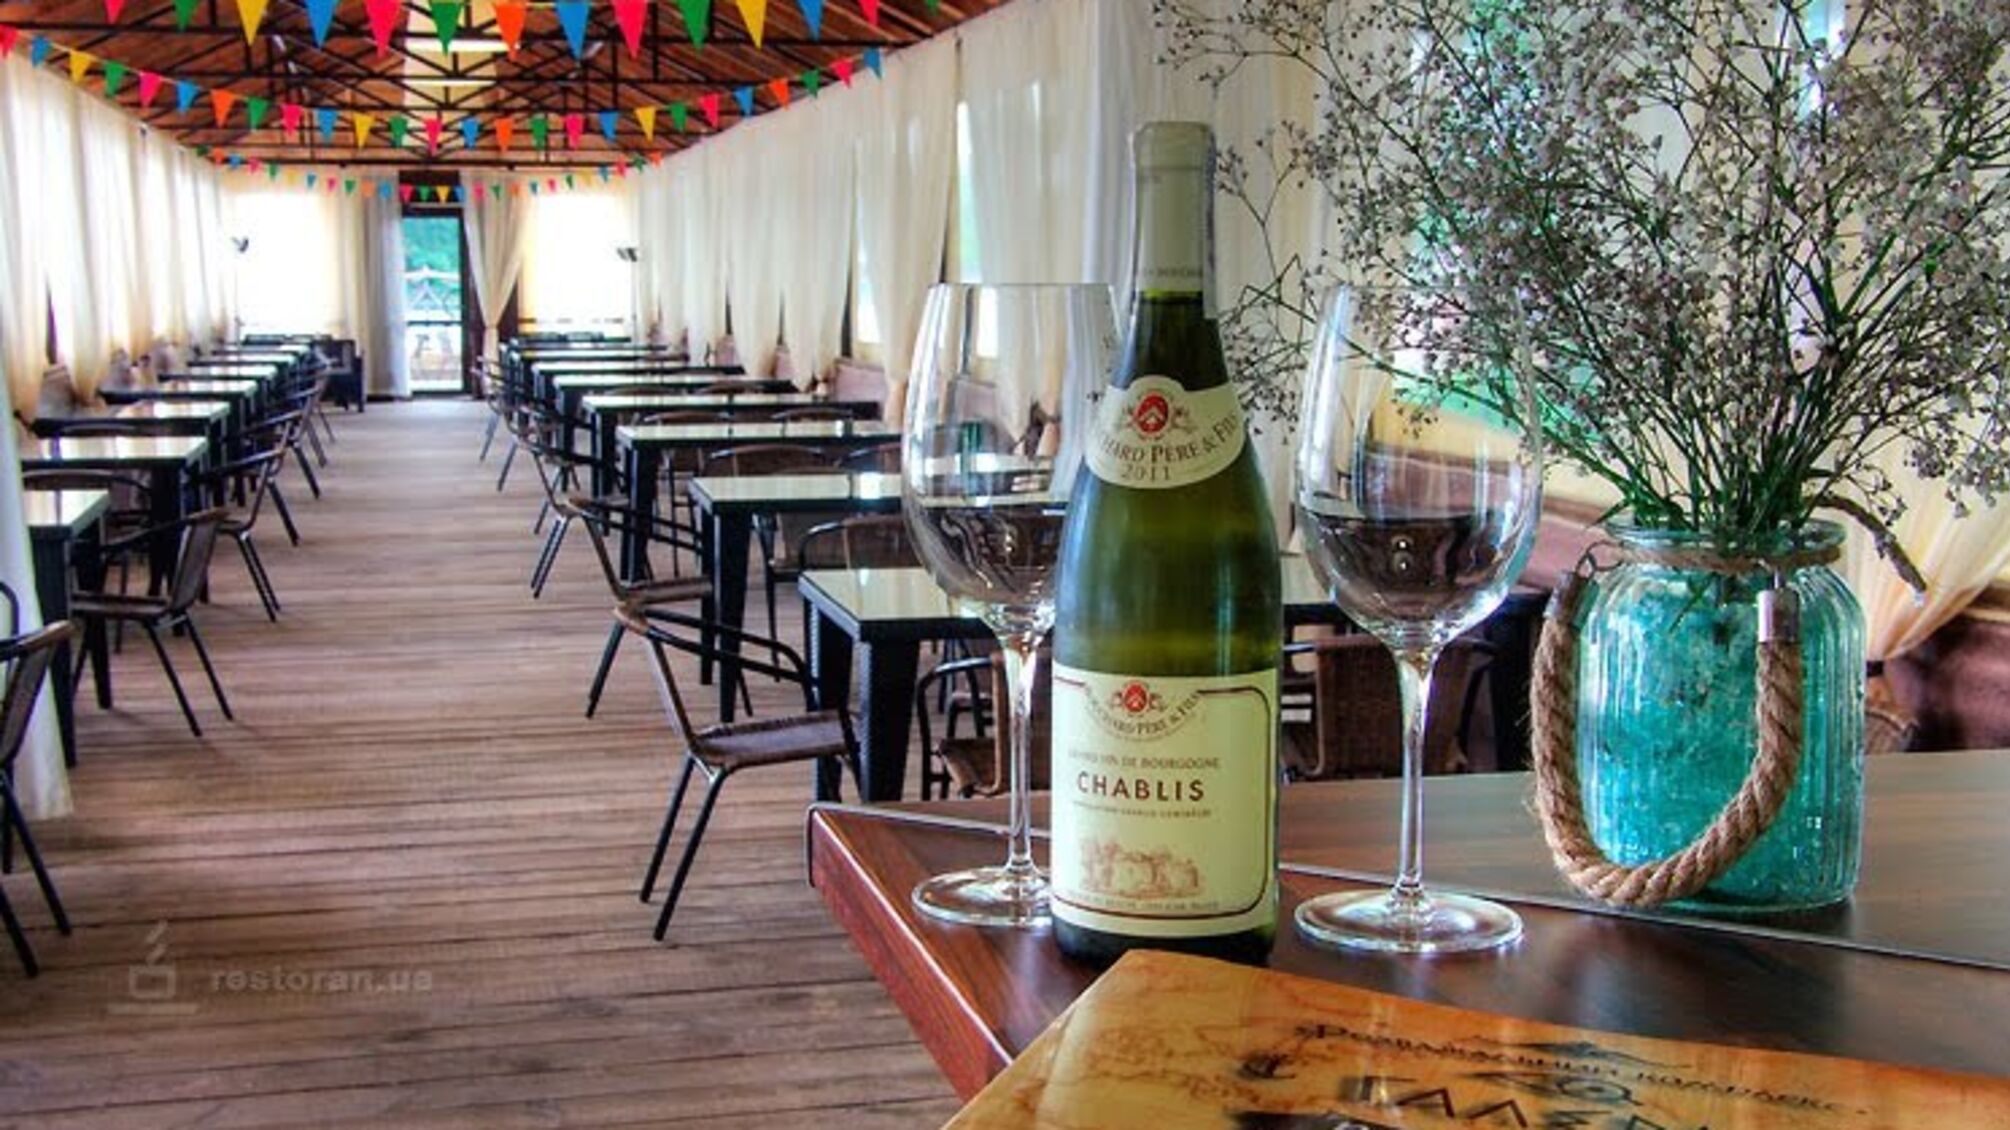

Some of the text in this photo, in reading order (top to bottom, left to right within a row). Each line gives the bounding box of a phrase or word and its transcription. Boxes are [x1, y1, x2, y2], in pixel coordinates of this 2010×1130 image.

[1202, 435, 1217, 454] &
[1120, 462, 1172, 483] 2011
[1121, 756, 1138, 768] DE
[1140, 756, 1220, 771] BOURGOGNE
[1077, 770, 1205, 802] CHABLIS
